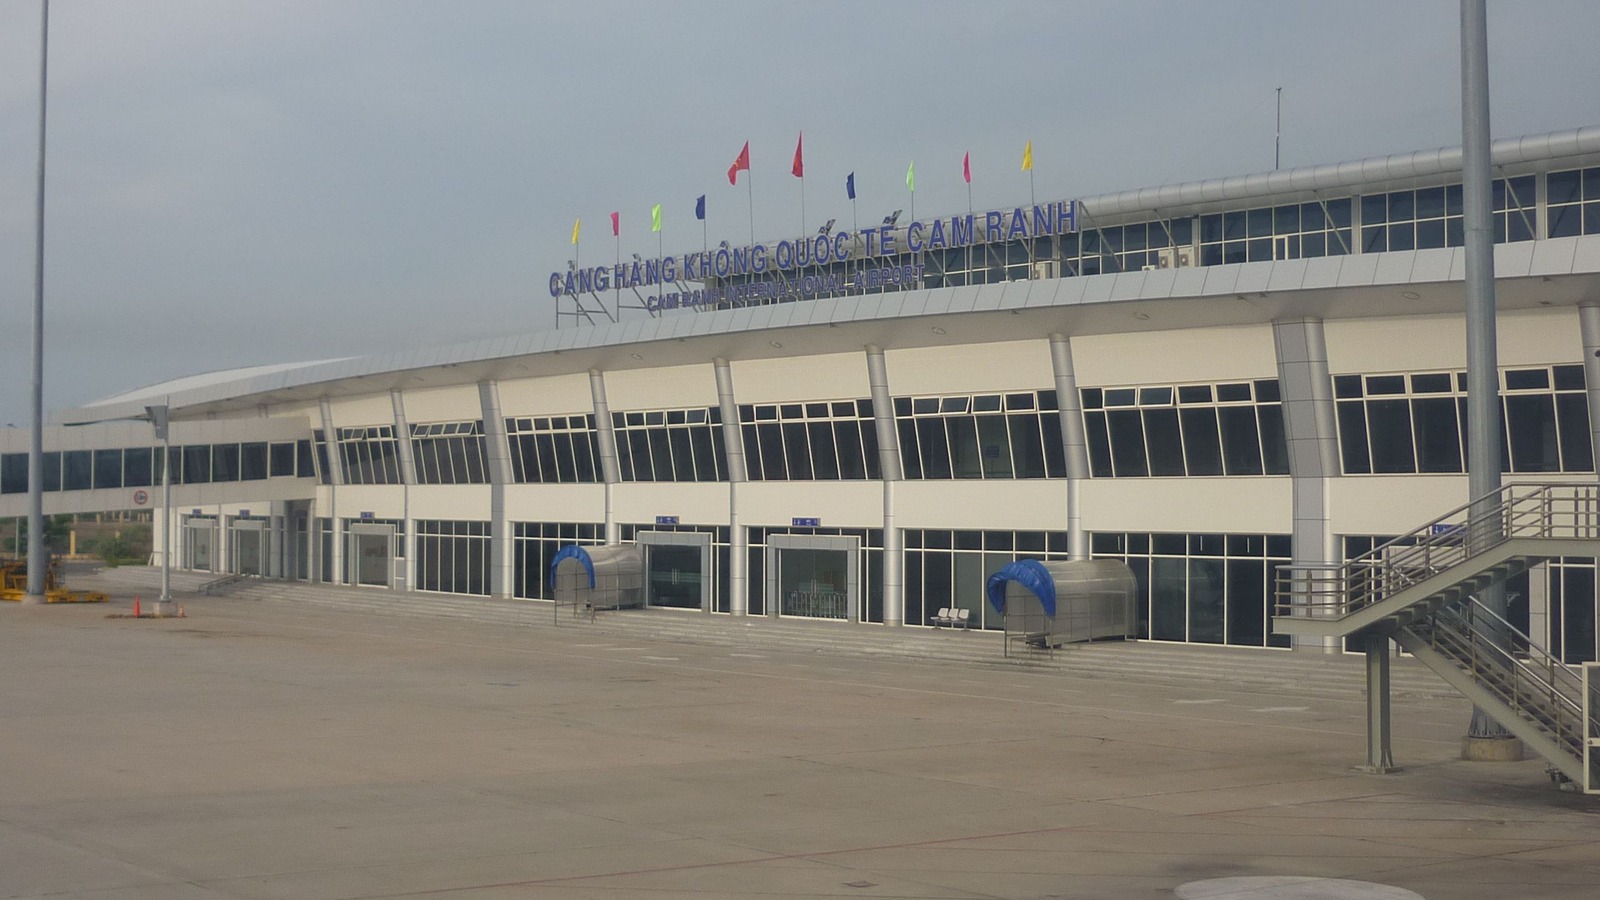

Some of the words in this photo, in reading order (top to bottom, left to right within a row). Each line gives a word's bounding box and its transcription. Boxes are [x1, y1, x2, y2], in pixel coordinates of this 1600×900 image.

[549, 260, 609, 297] CẢNG
[614, 253, 675, 289] HÀNG
[684, 240, 767, 279] KHÔNG
[775, 218, 849, 270] QUỐC
[861, 209, 902, 257] TẾ
[907, 214, 975, 253] CAM
[986, 200, 1077, 244] RANH
[647, 292, 679, 312] CAM
[682, 287, 720, 307] RANH
[724, 272, 847, 304] INTERNATIONAL
[854, 262, 925, 290] AIRPORT
